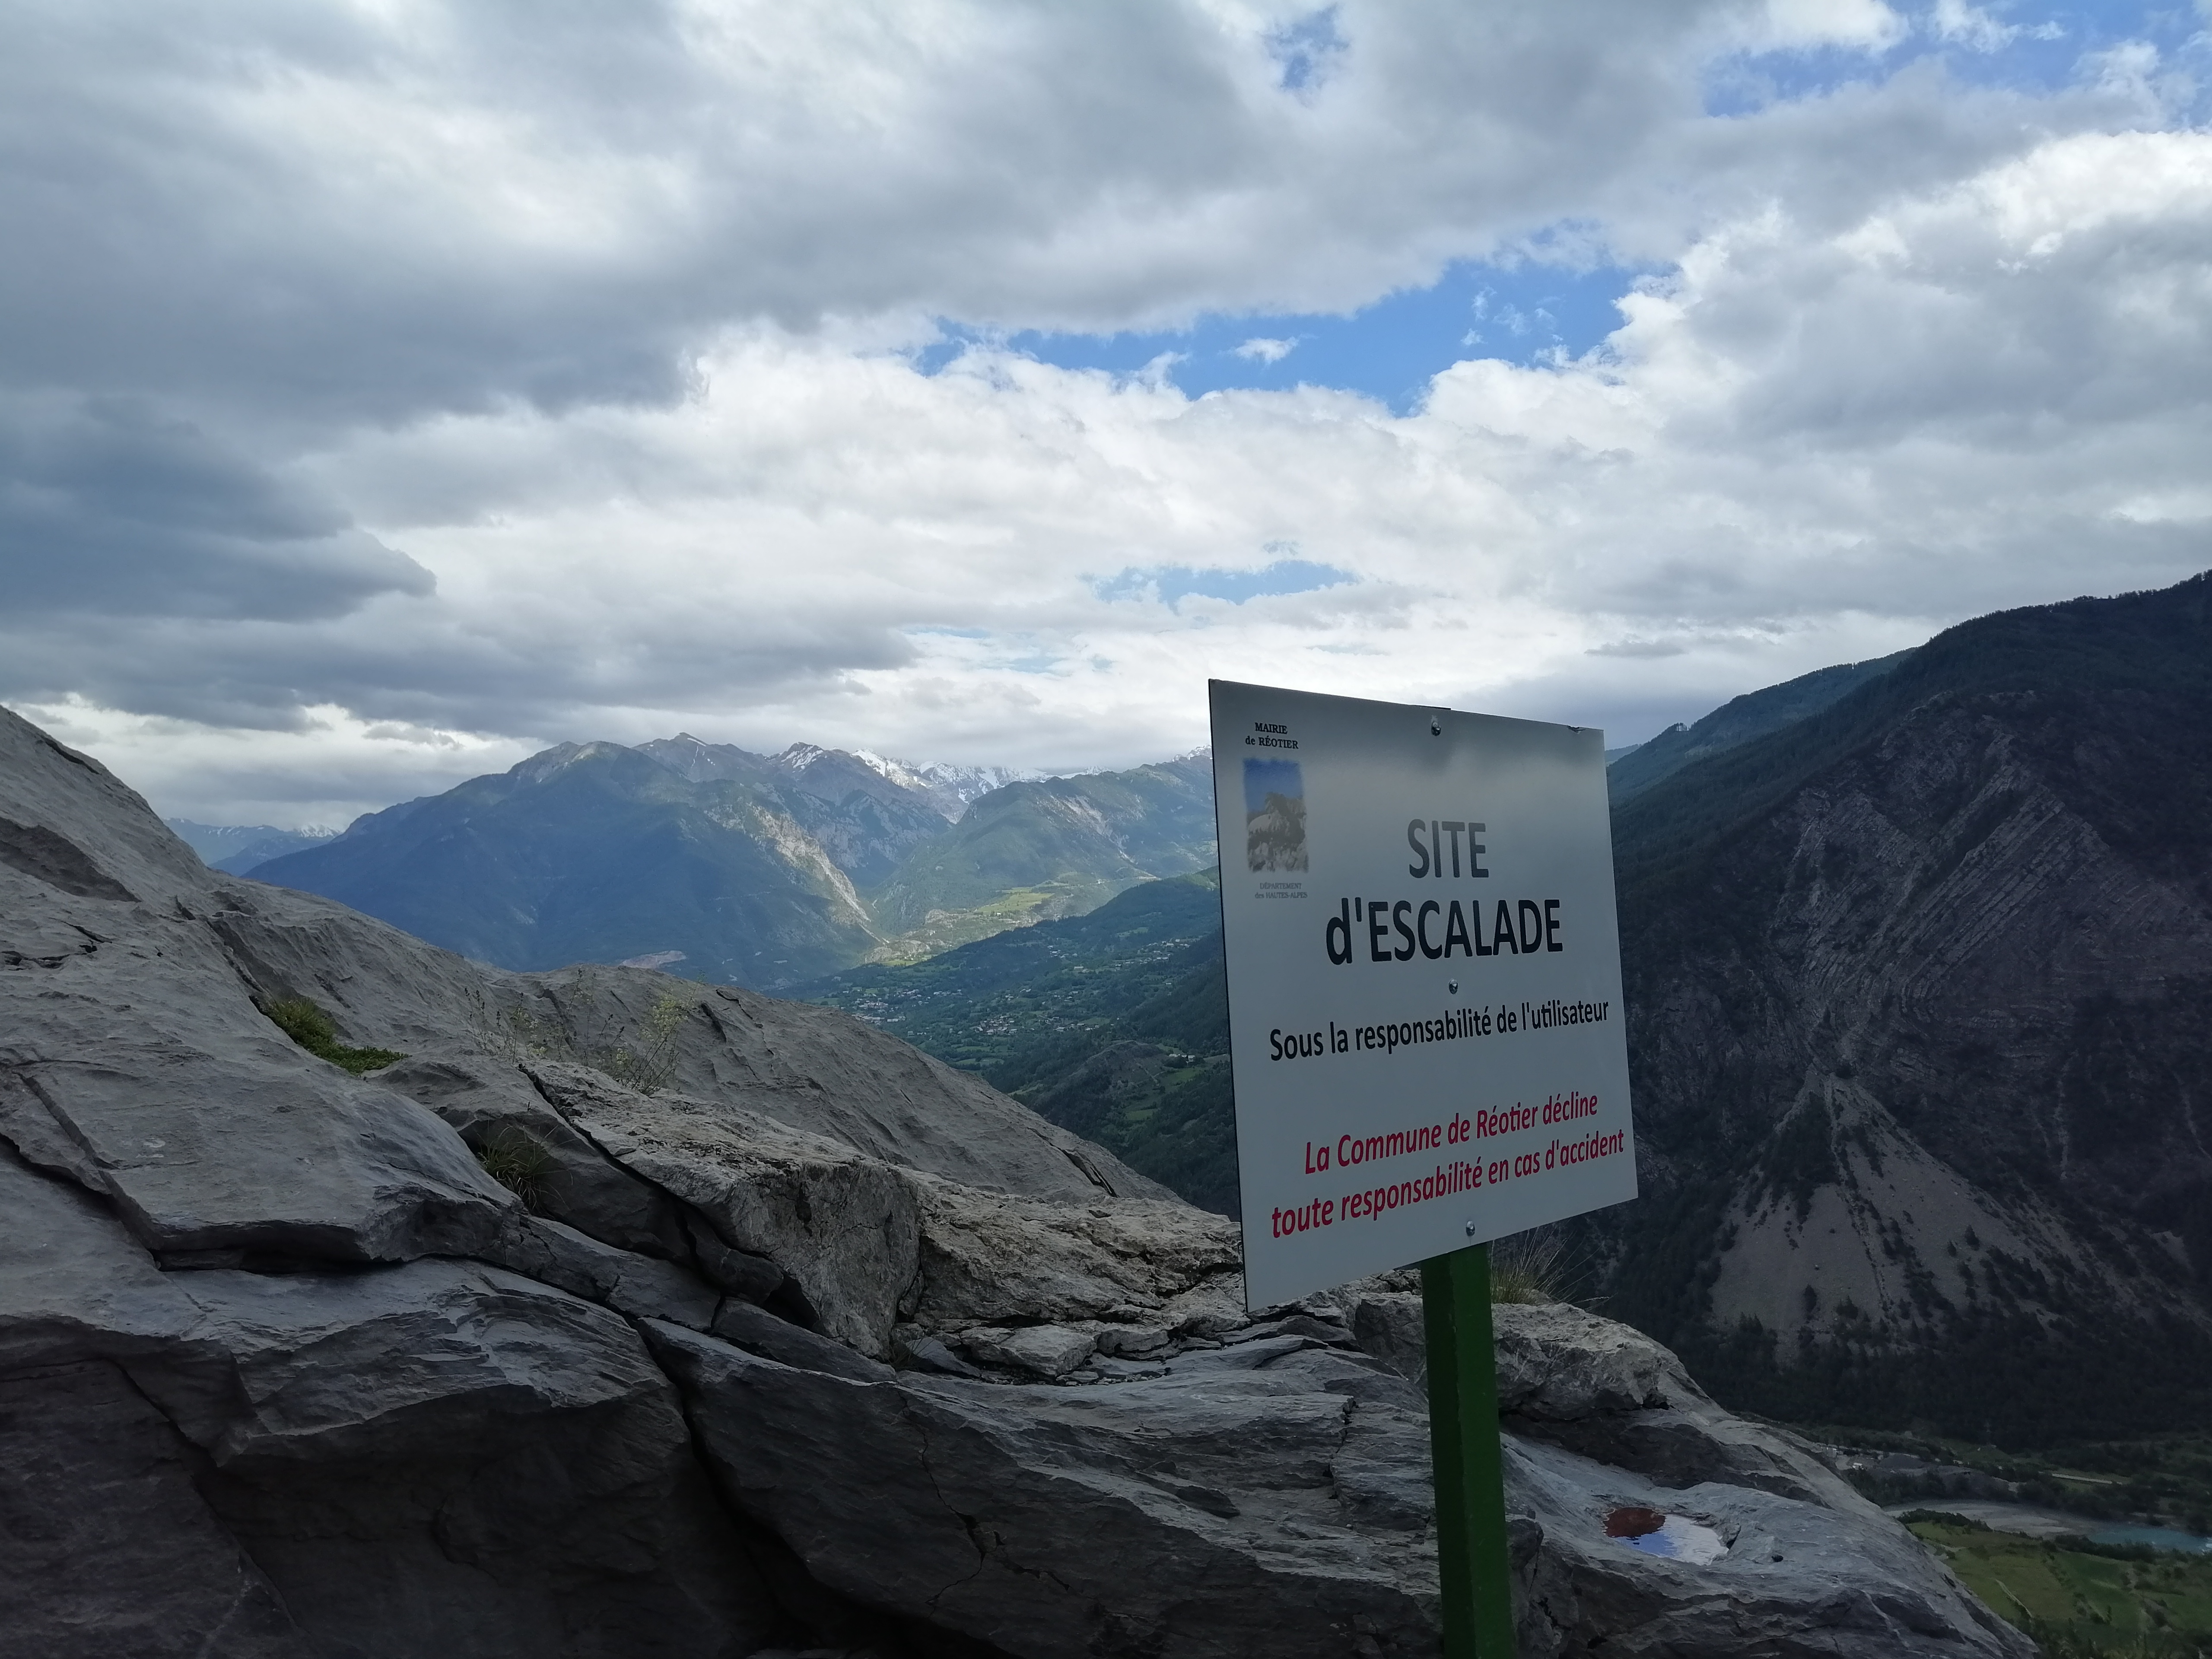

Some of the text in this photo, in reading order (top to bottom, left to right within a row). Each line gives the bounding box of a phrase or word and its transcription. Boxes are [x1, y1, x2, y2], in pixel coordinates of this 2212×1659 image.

[1245, 735, 1299, 749] de RÉOTIER
[1255, 722, 1287, 734] MAIRIE
[1408, 819, 1489, 878] SITE
[1326, 897, 1563, 965] d'ESCALADE
[1270, 999, 1609, 1061] Sous la responsabilité de l'utilisateur
[1305, 1092, 1598, 1174] La Commune de Réotier décline
[1271, 1129, 1624, 1238] toute responsabilité en cas d'accident
